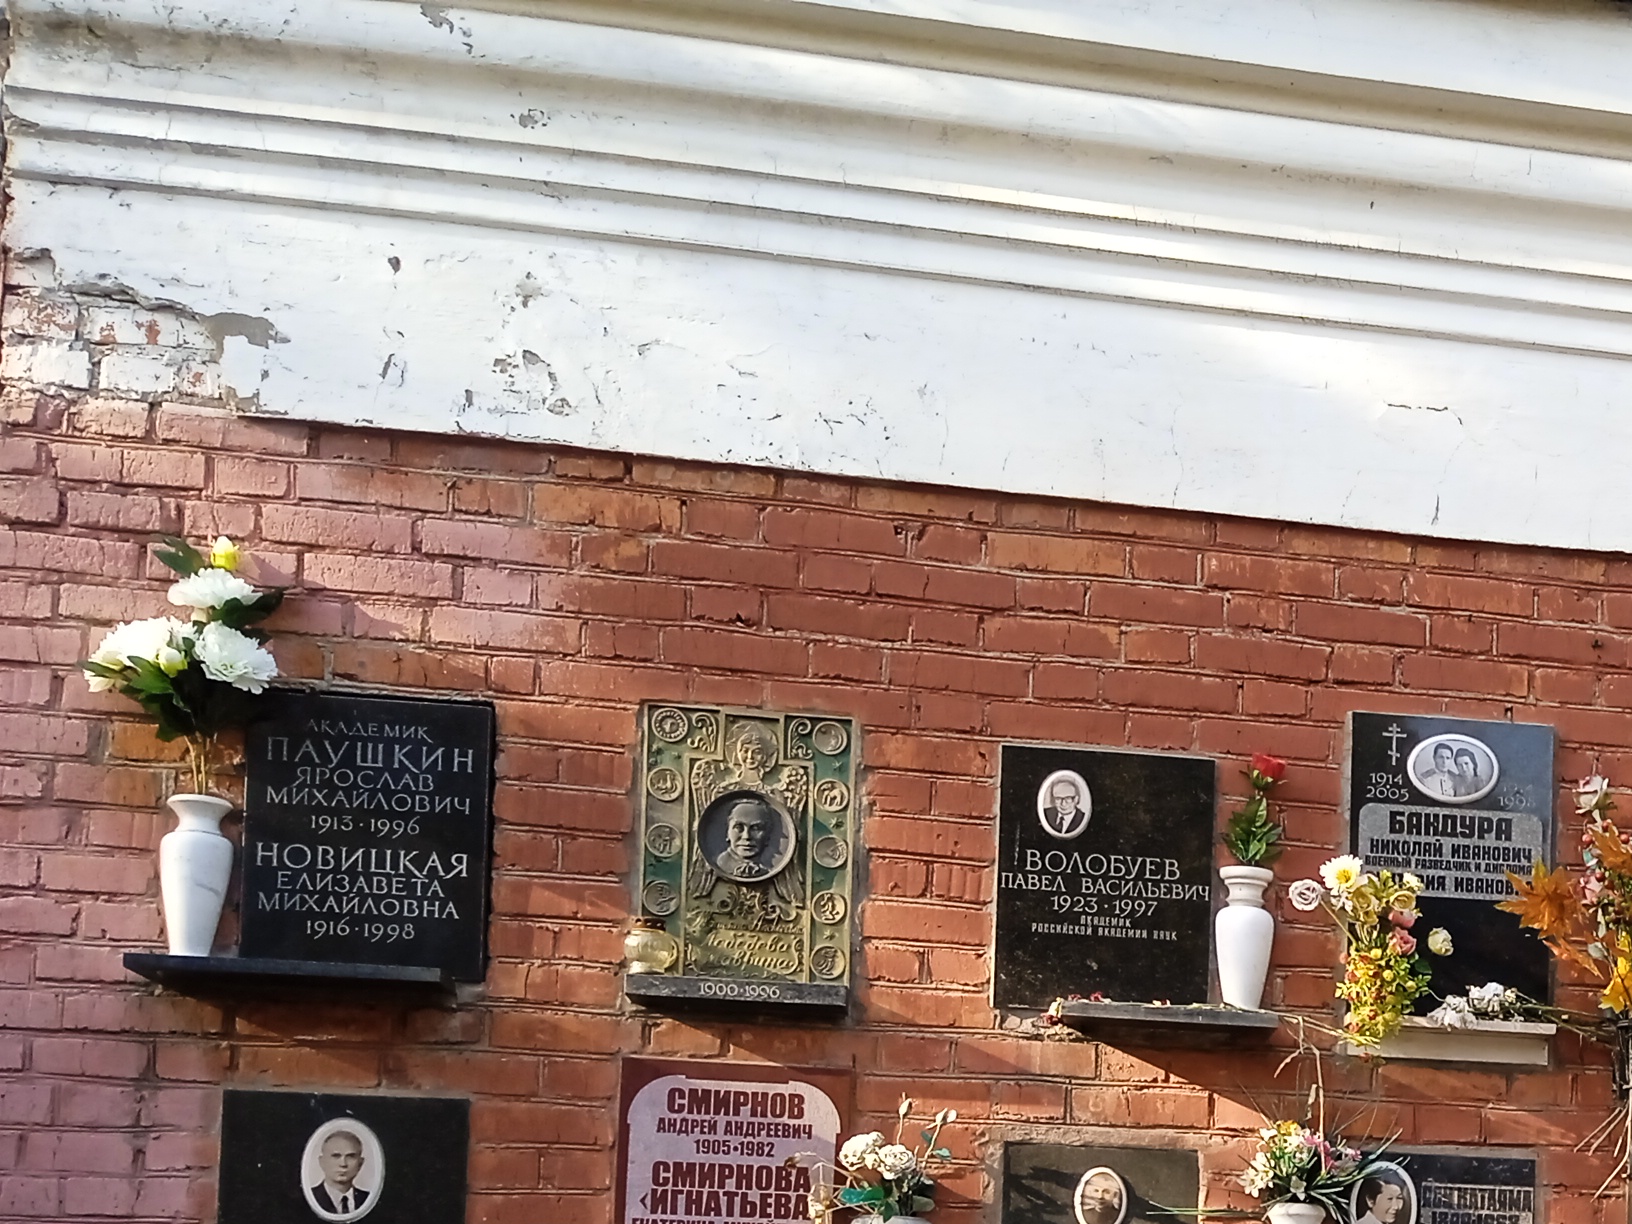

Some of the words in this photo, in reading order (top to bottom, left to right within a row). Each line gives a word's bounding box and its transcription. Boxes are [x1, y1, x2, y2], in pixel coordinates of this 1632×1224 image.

[308, 719, 433, 743] АКАДЕМИК
[266, 736, 474, 772] ПАУШКИН
[294, 766, 435, 791] ЯРОСЛАВ
[1369, 773, 1403, 787] 1914
[266, 786, 471, 815] МИХАЙЛОВИЧ
[1366, 786, 1409, 801] 2005
[1389, 811, 1513, 841] БАНДУРА
[255, 842, 469, 879] НОВИЦКАЯ
[1365, 854, 1411, 868] ВОЕННЫЙ
[1415, 859, 1471, 871] РАЗВЕДЧИК
[1474, 864, 1481, 872] И
[1370, 838, 1443, 858] НИКОЛАЙ
[1451, 843, 1532, 863] ИВАНОВИЧ
[1025, 849, 1181, 880] ВОЛОБУЕВ
[276, 871, 446, 898] ЕЛИЗАВЕТА
[1001, 872, 1066, 892] ПАВЕЛ
[1081, 878, 1209, 901] ВАСИЛЬЕВИЧ
[257, 892, 460, 920] МИХАЙЛОВНА
[1031, 922, 1092, 936] РОССИЙСКОЙ
[1153, 930, 1177, 940] НАУК
[1080, 915, 1131, 927] АКАДЕМИК
[667, 1087, 806, 1120] СМИРНОВ
[656, 1116, 717, 1137] АНДРЕЙ
[724, 1122, 813, 1140] АНДРЕЕВИЧ
[652, 1160, 811, 1193] СМИРНОВА
